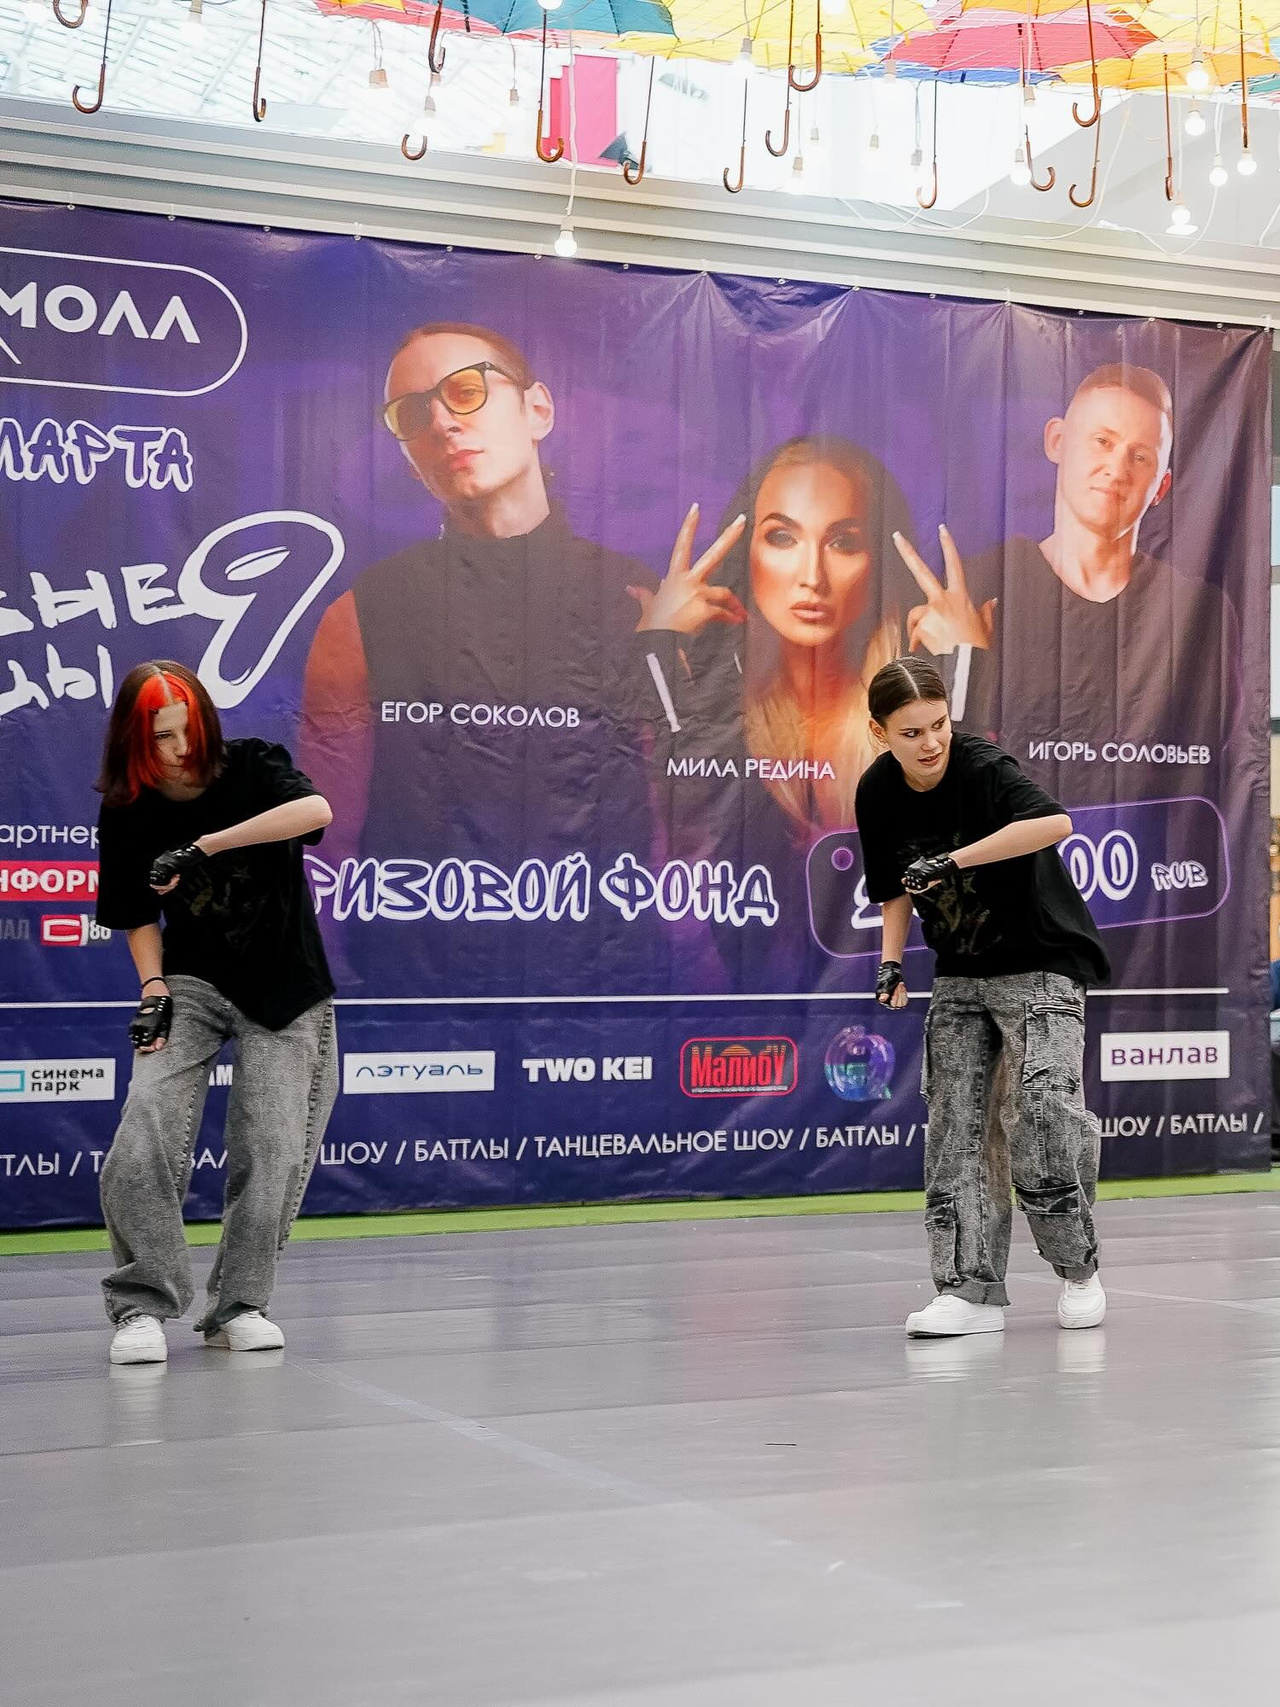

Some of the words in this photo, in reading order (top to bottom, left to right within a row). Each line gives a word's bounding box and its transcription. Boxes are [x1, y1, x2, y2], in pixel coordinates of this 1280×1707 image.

[381, 701, 444, 723] ЕГОР
[450, 703, 581, 728] СОКОЛОВ
[1028, 741, 1097, 761] ИГОРЬ
[1101, 742, 1211, 764] СОЛОВЬЕВ
[666, 757, 739, 778] МИЛА
[745, 758, 836, 781] РЕДИНА
[302, 851, 591, 922] РИЗОВОЙ
[599, 852, 780, 927] ФОНД
[1150, 860, 1208, 891] RUB
[1111, 1046, 1218, 1066] ванлав
[31, 1068, 105, 1080] синема
[522, 1058, 596, 1082] TWO
[602, 1056, 653, 1080] KEI
[31, 1079, 81, 1095] парк
[1100, 1115, 1151, 1138] ШОУ
[1170, 1113, 1248, 1135] БАТТЛЫ
[320, 1141, 388, 1165] ШОУ
[414, 1137, 509, 1162] БАТТЛЫ
[534, 1130, 727, 1158] ТАНЦЕВАЛЬНОЕ
[733, 1128, 794, 1151] ШОУ
[815, 1125, 899, 1148] БАТТЛЫ
